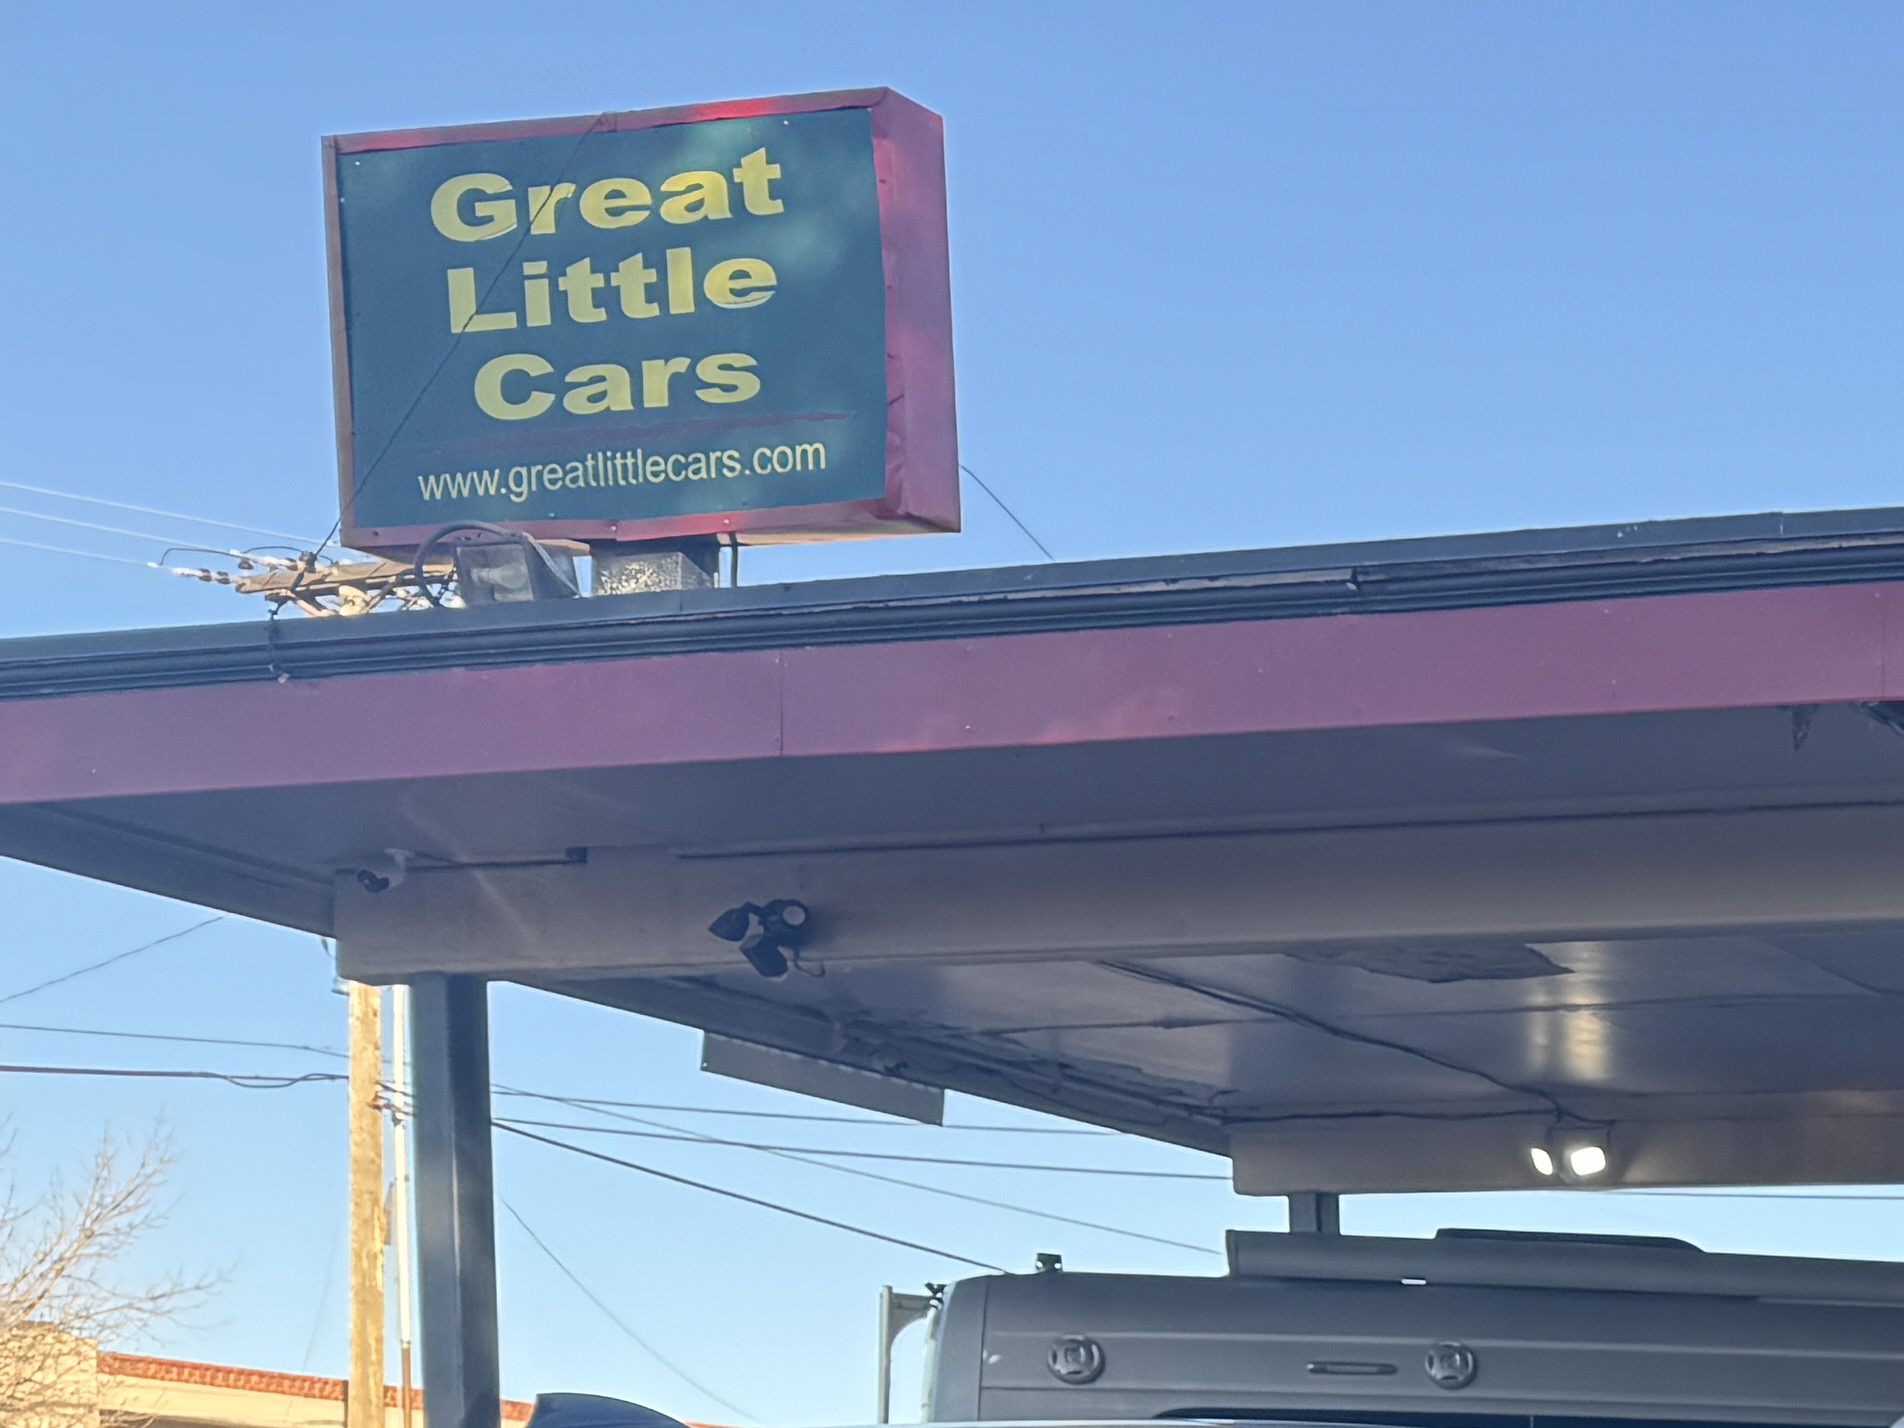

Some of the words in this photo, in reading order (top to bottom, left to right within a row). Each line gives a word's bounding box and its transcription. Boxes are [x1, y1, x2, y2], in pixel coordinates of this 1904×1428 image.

[430, 146, 785, 242] Great
[446, 246, 778, 334] Little
[473, 352, 761, 421] Cars
[417, 441, 827, 504] www.greatlittlecars.com
